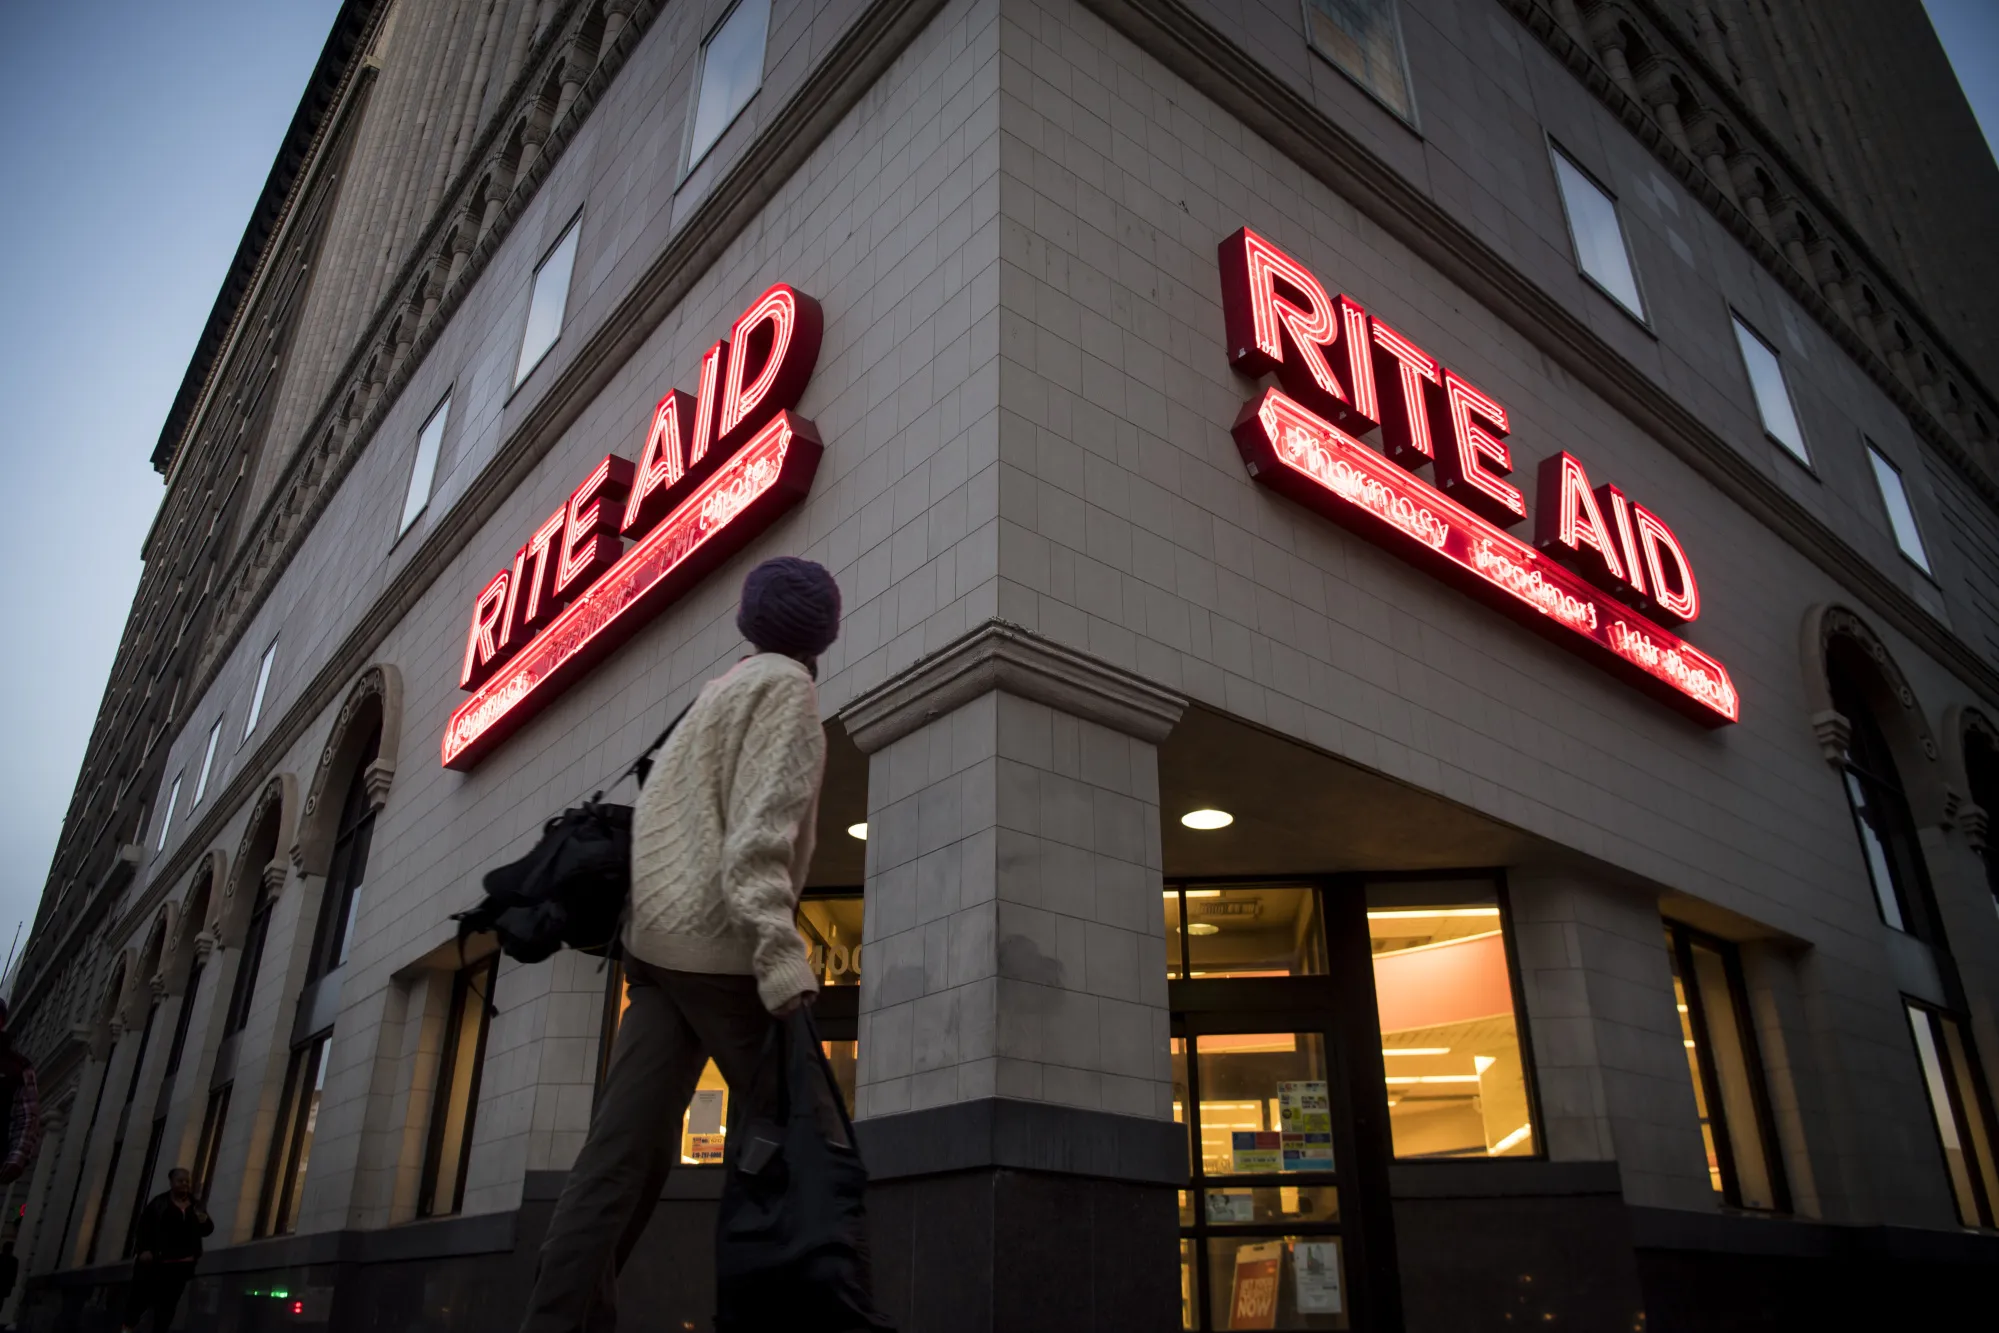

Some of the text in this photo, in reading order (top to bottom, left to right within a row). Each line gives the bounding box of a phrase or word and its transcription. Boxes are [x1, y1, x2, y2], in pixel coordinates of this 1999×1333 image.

[460, 282, 797, 690] RITE AID
[1241, 226, 1700, 623] RITE AID
[1289, 426, 1449, 548] Pharmacy
[1664, 649, 1721, 700] Photo
[452, 669, 535, 751] Pharmacy
[699, 456, 769, 530] Photo
[1237, 1298, 1272, 1319] NOW
